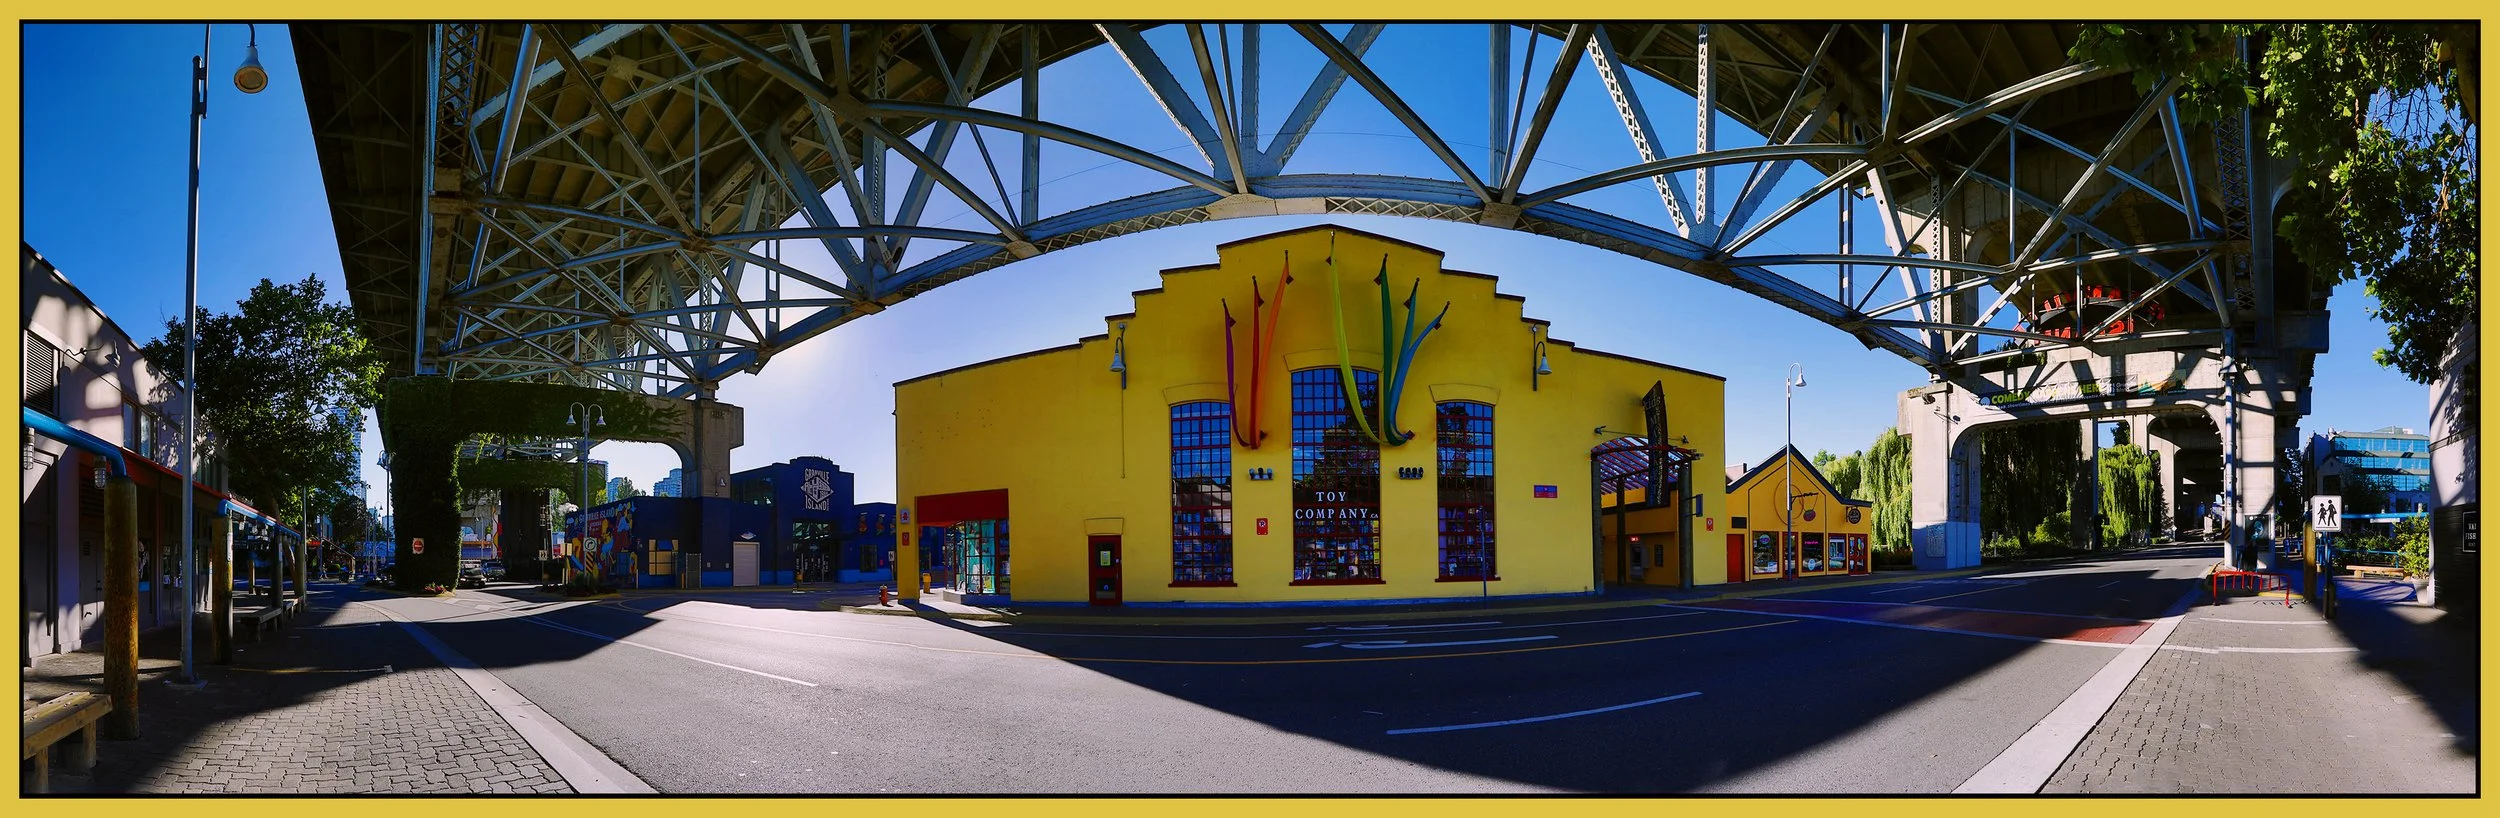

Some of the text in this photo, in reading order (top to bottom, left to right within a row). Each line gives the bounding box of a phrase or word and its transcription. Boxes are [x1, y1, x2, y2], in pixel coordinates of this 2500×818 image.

[1991, 391, 2031, 405] COMEDY
[804, 468, 830, 485] GRANVILLE
[805, 495, 827, 511] ISLAND
[1315, 491, 1346, 502] TOY
